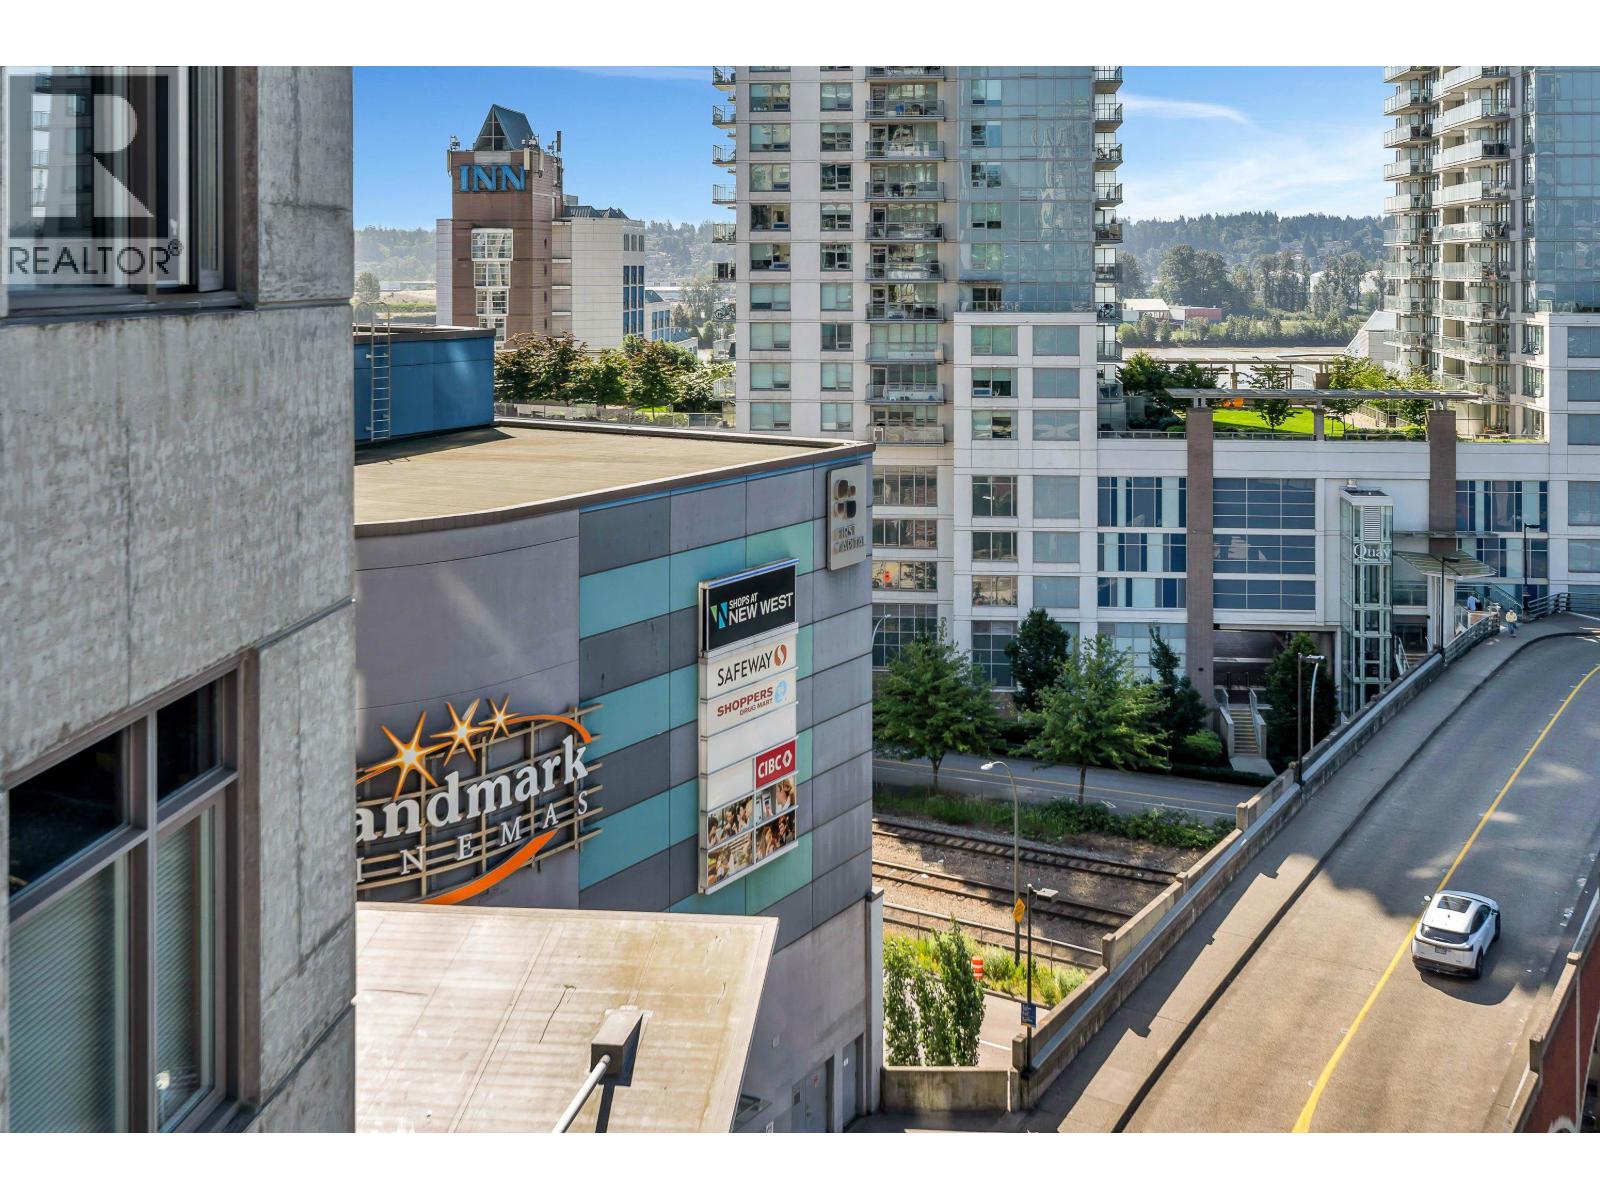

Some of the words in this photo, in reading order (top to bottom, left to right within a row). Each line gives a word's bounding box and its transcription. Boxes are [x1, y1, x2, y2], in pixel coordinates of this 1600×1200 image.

[459, 164, 527, 192] INN
[1353, 543, 1390, 561] Quay
[728, 602, 758, 626] NEW
[760, 591, 794, 616] WEST
[729, 594, 750, 610] SHOPS
[750, 591, 759, 604] AT
[717, 650, 773, 687] SAFEWAY
[717, 686, 774, 717] SHOPPERS
[739, 704, 757, 716] DRUG
[756, 697, 773, 709] MART
[757, 754, 782, 779] CIBC
